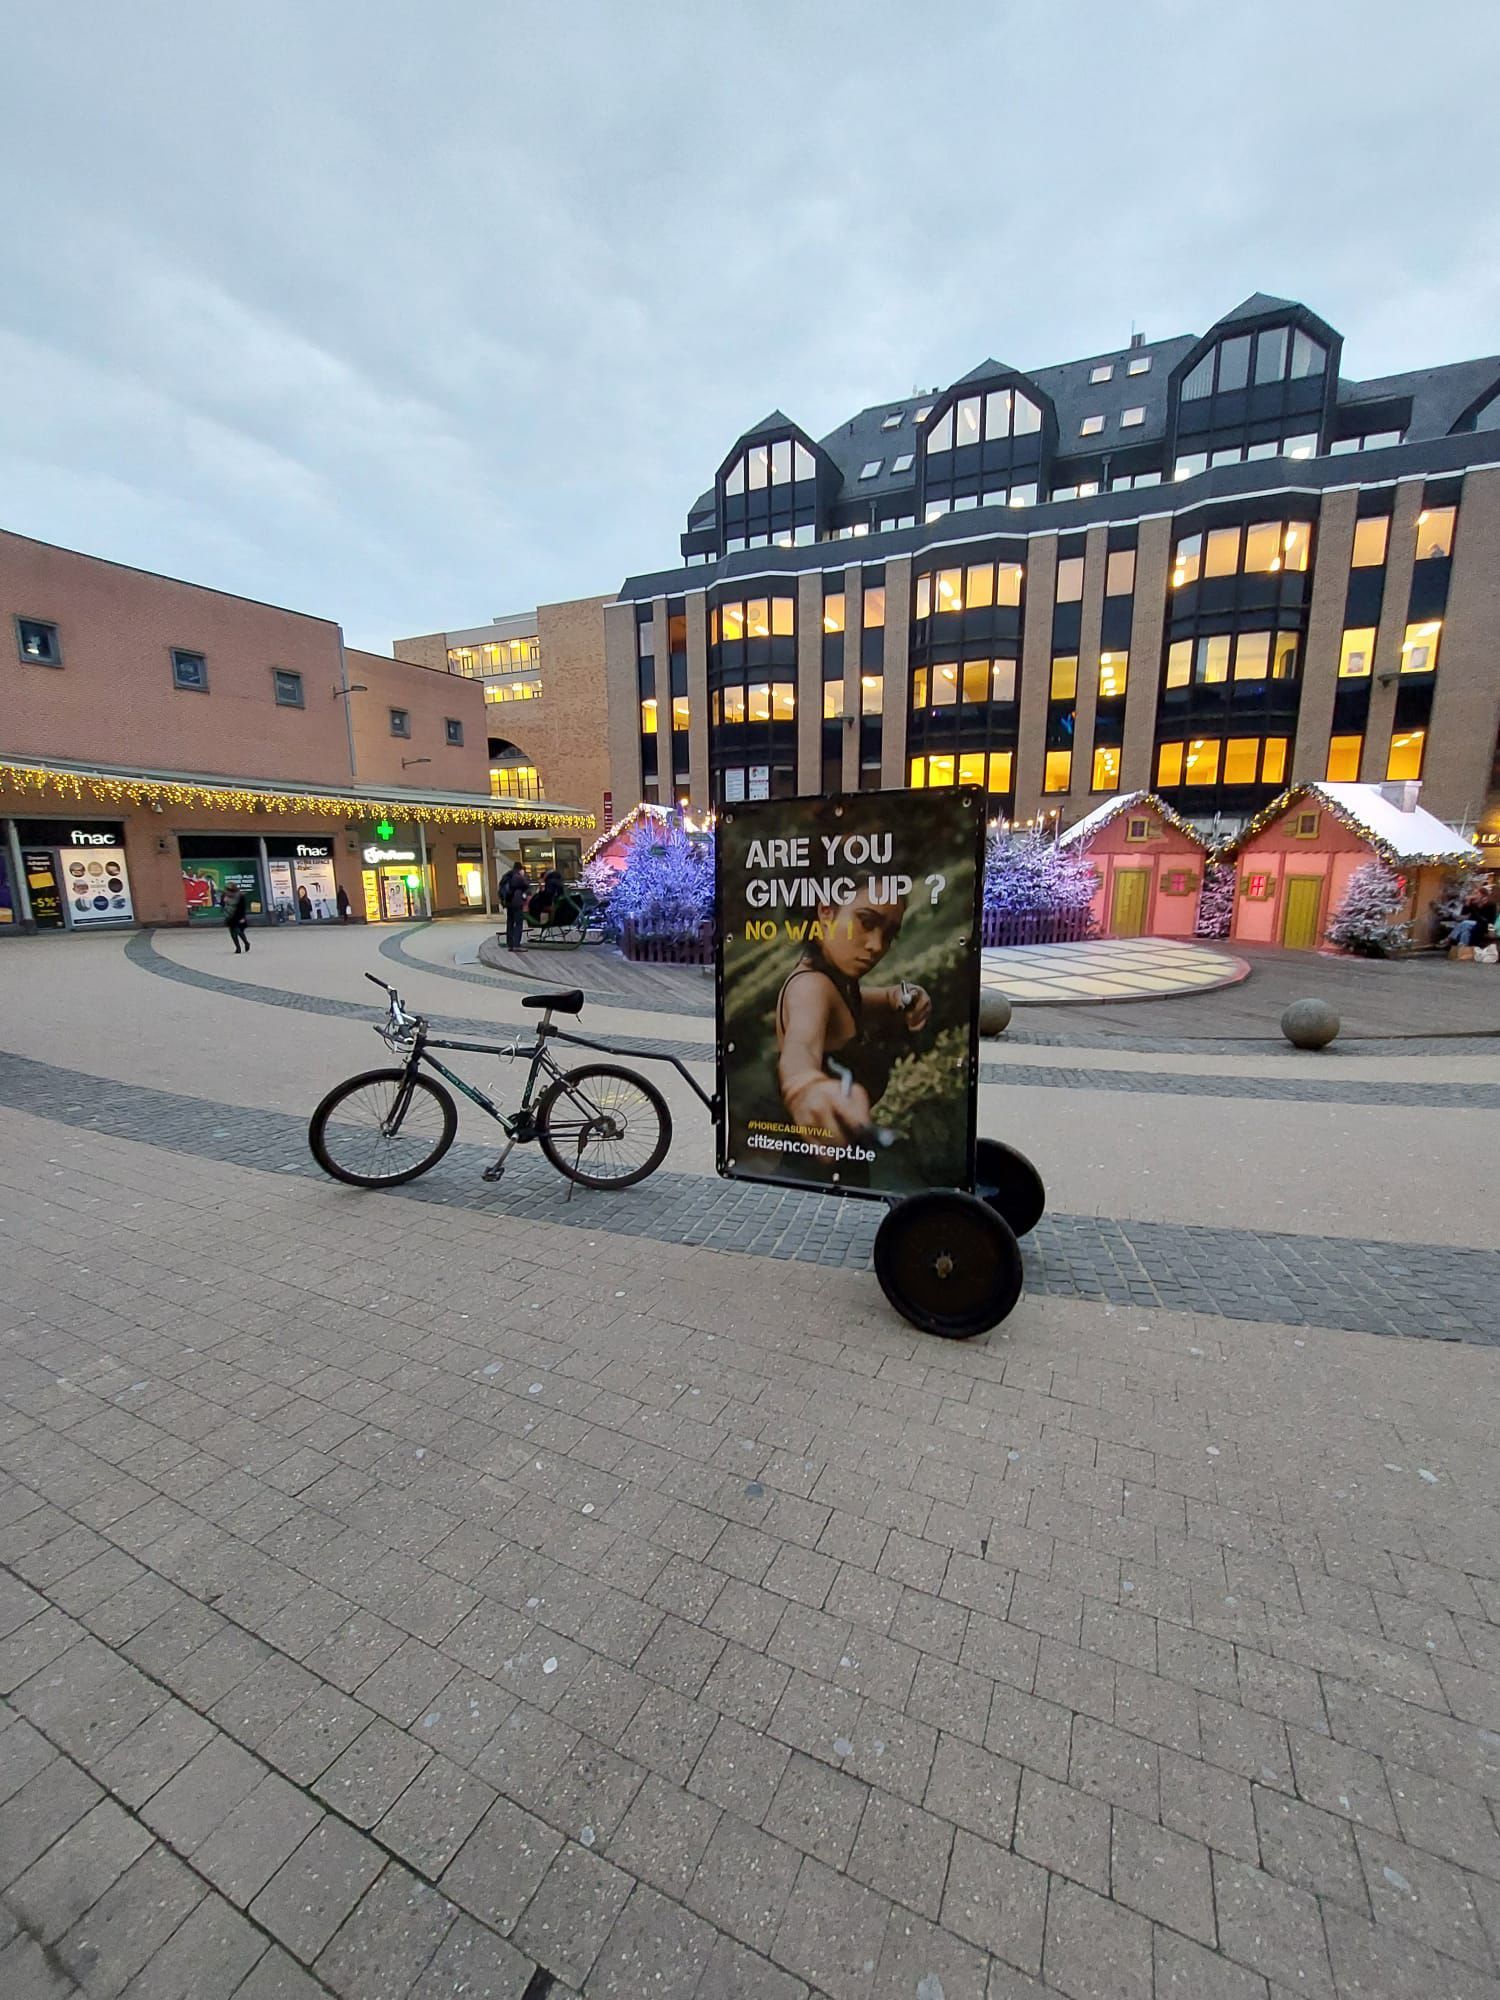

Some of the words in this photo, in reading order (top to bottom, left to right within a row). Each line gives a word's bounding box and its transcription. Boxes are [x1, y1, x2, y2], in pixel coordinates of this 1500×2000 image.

[71, 830, 116, 845] fnac
[296, 844, 328, 857] fnac
[745, 837, 810, 869] ARE
[821, 832, 893, 866] YOU
[745, 876, 857, 909] GIVING
[868, 874, 913, 906] UP
[924, 873, 946, 905] ?
[745, 920, 777, 941] NO
[784, 919, 838, 941] WAY
[747, 1120, 834, 1137] #HORECASURVIVAL
[747, 1133, 876, 1161] citizenconcept.be
